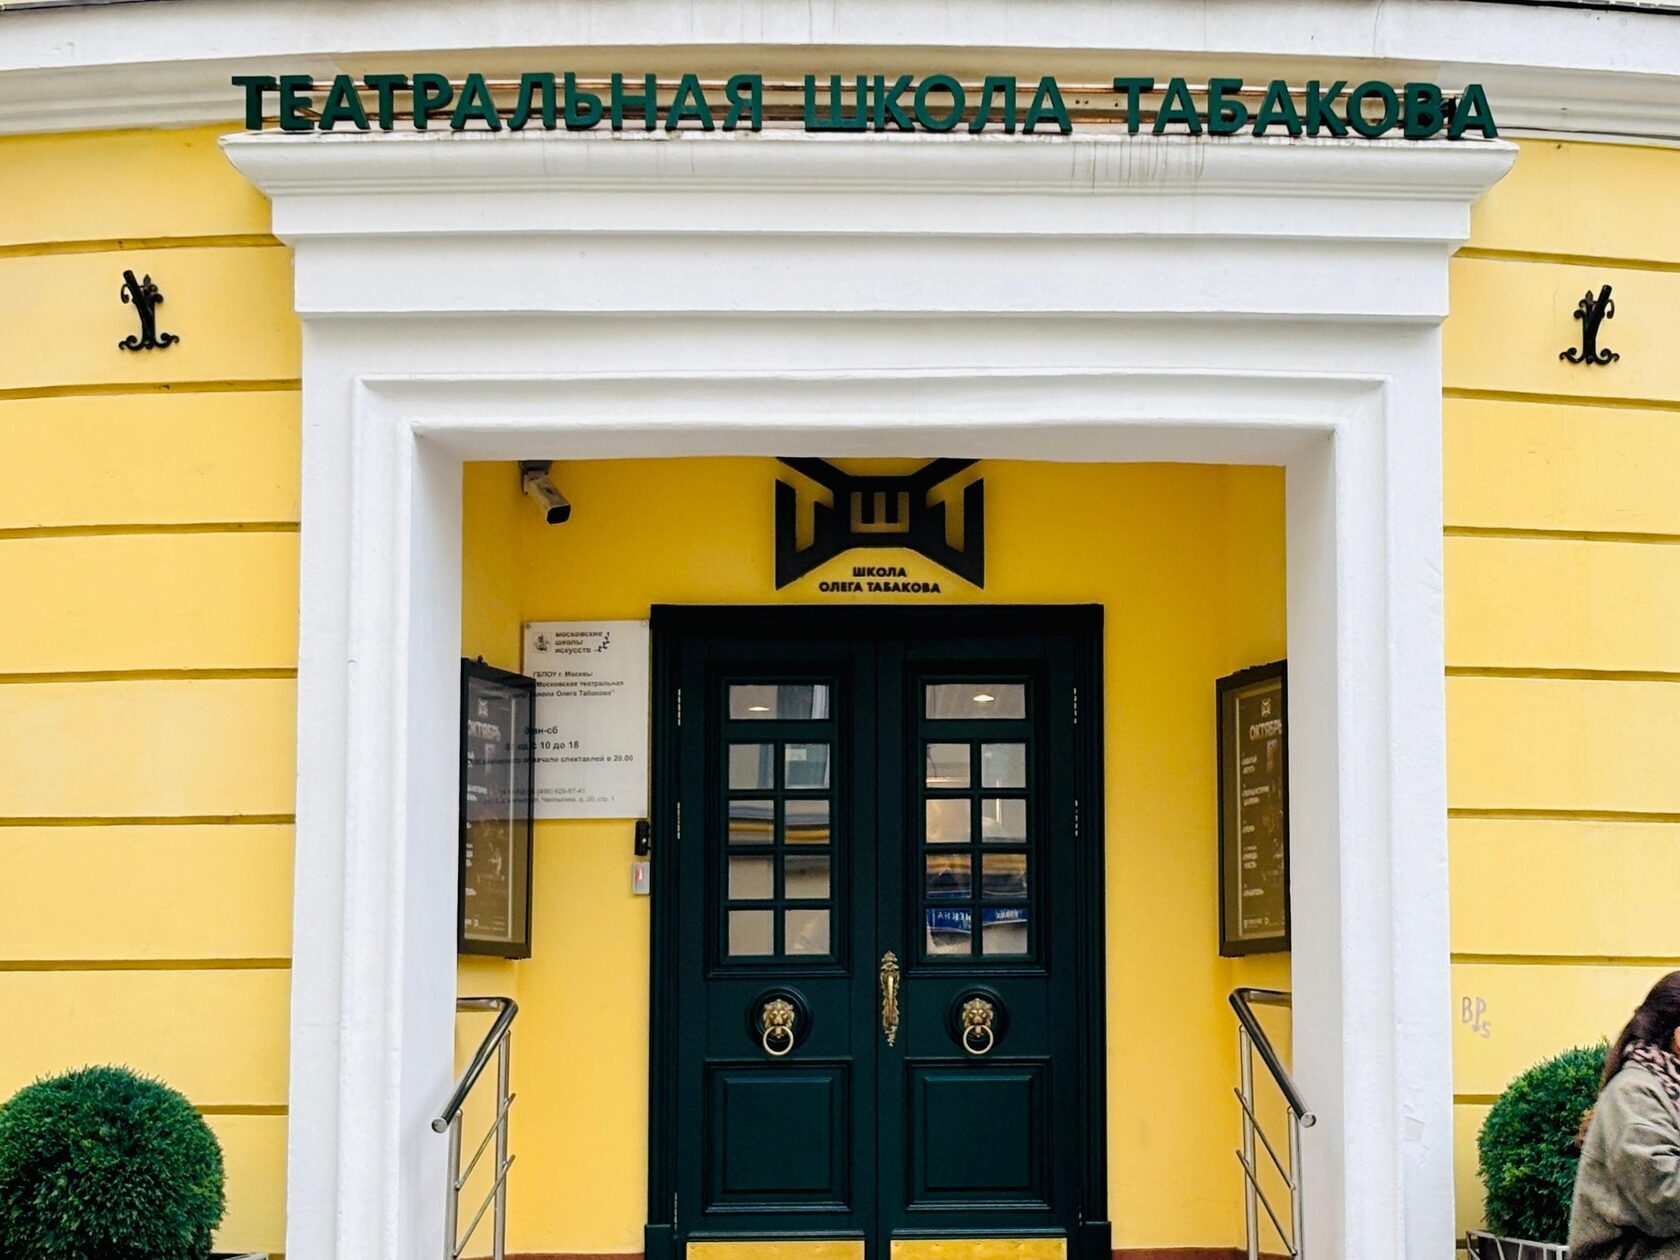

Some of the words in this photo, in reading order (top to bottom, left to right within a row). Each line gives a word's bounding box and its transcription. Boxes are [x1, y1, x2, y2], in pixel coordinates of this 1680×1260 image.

[231, 72, 763, 132] ТЕАТРАЛЬНАЯ
[803, 75, 1073, 134] ШКОЛА
[1112, 77, 1499, 141] ТАБАКОВА
[852, 566, 908, 578] ШКОЛА
[818, 581, 864, 593] ОЛЕГА
[867, 582, 941, 594] ТАБАКОВА
[554, 647, 592, 655] искусств
[540, 741, 551, 749] 10
[552, 742, 566, 751] до
[569, 741, 580, 749] 18
[560, 755, 605, 763] спектаклей
